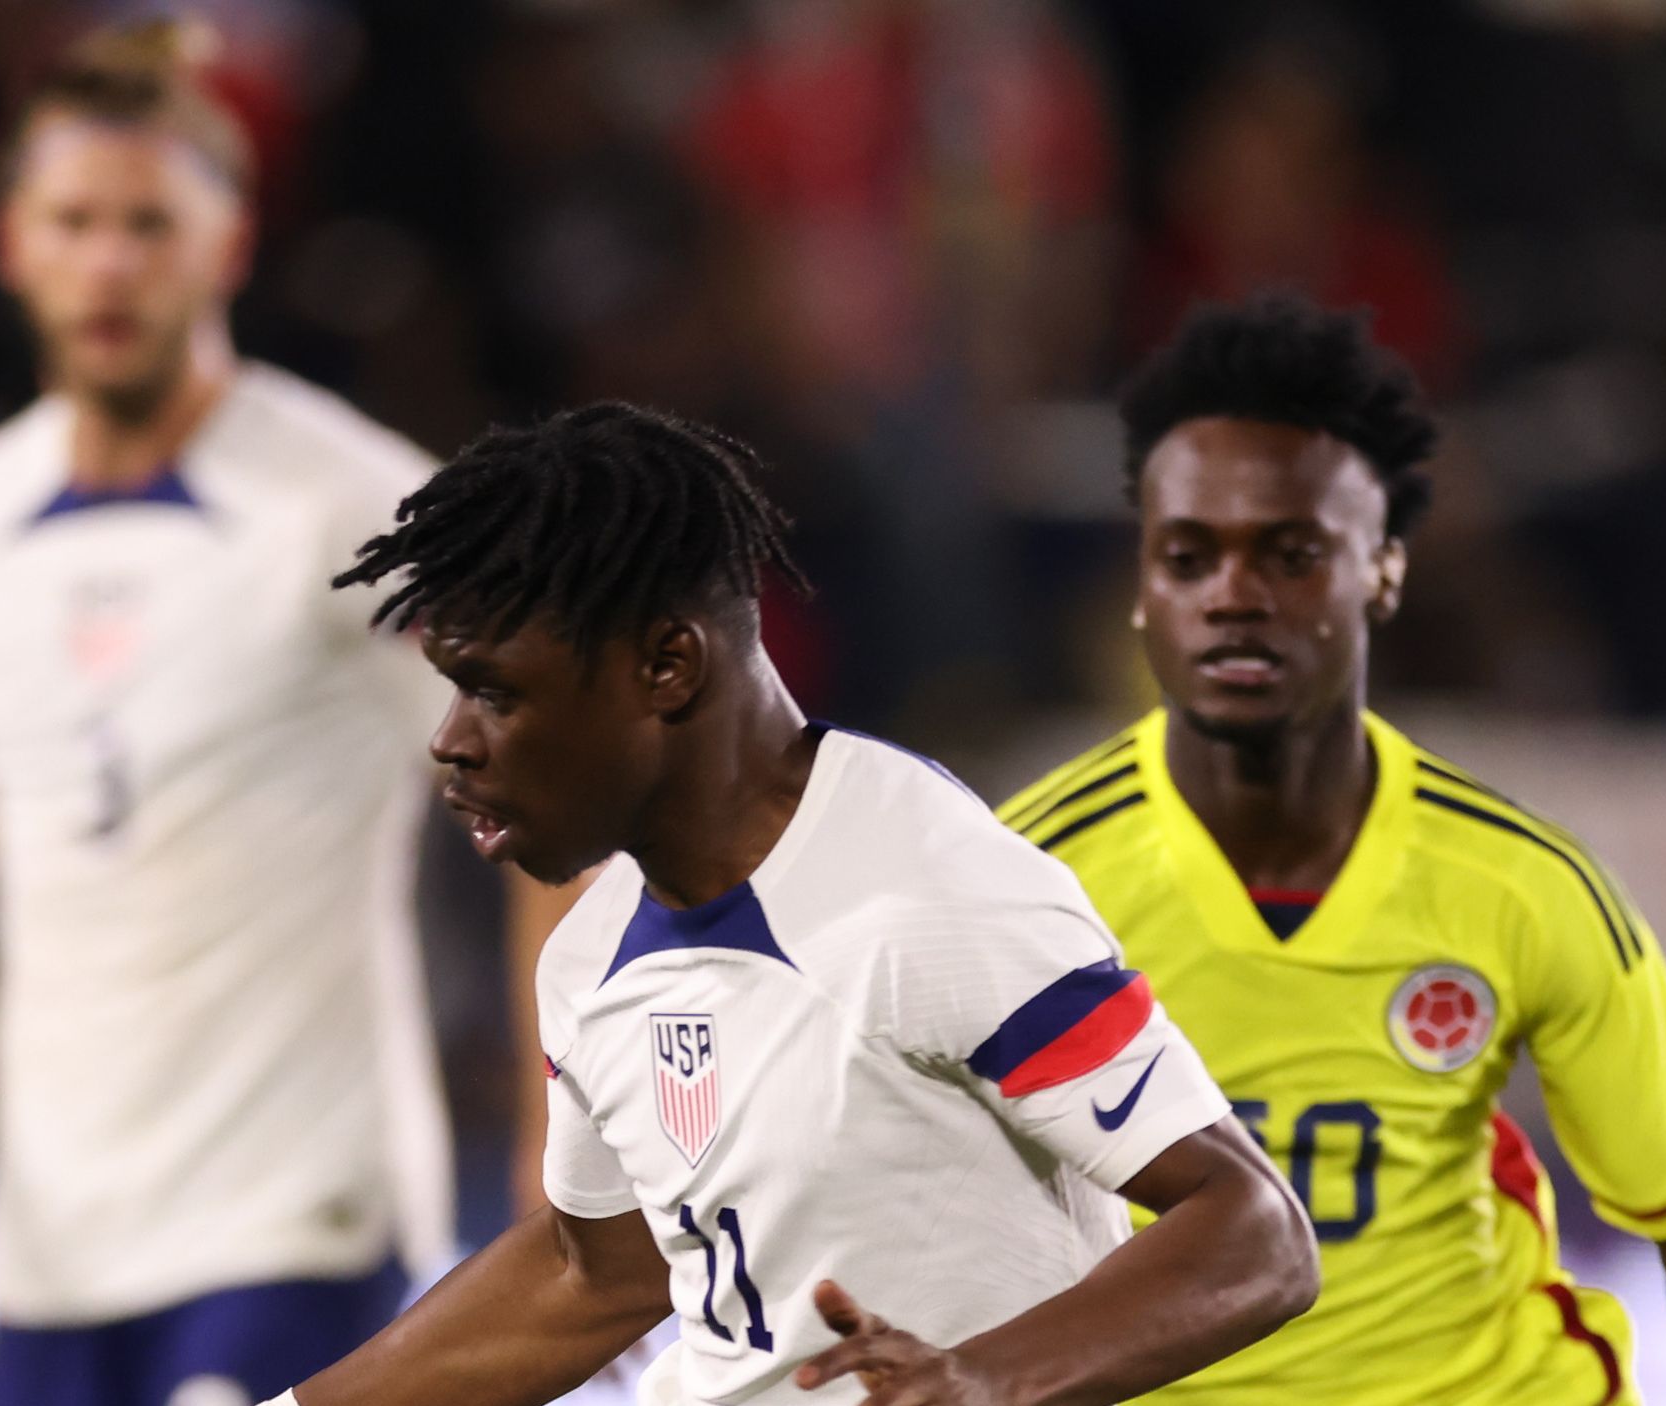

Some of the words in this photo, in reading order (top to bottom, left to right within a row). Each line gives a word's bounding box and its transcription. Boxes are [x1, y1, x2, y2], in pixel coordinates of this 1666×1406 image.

[656, 1022, 713, 1078] USA
[1229, 1098, 1382, 1244] 0
[678, 1202, 775, 1354] 11
